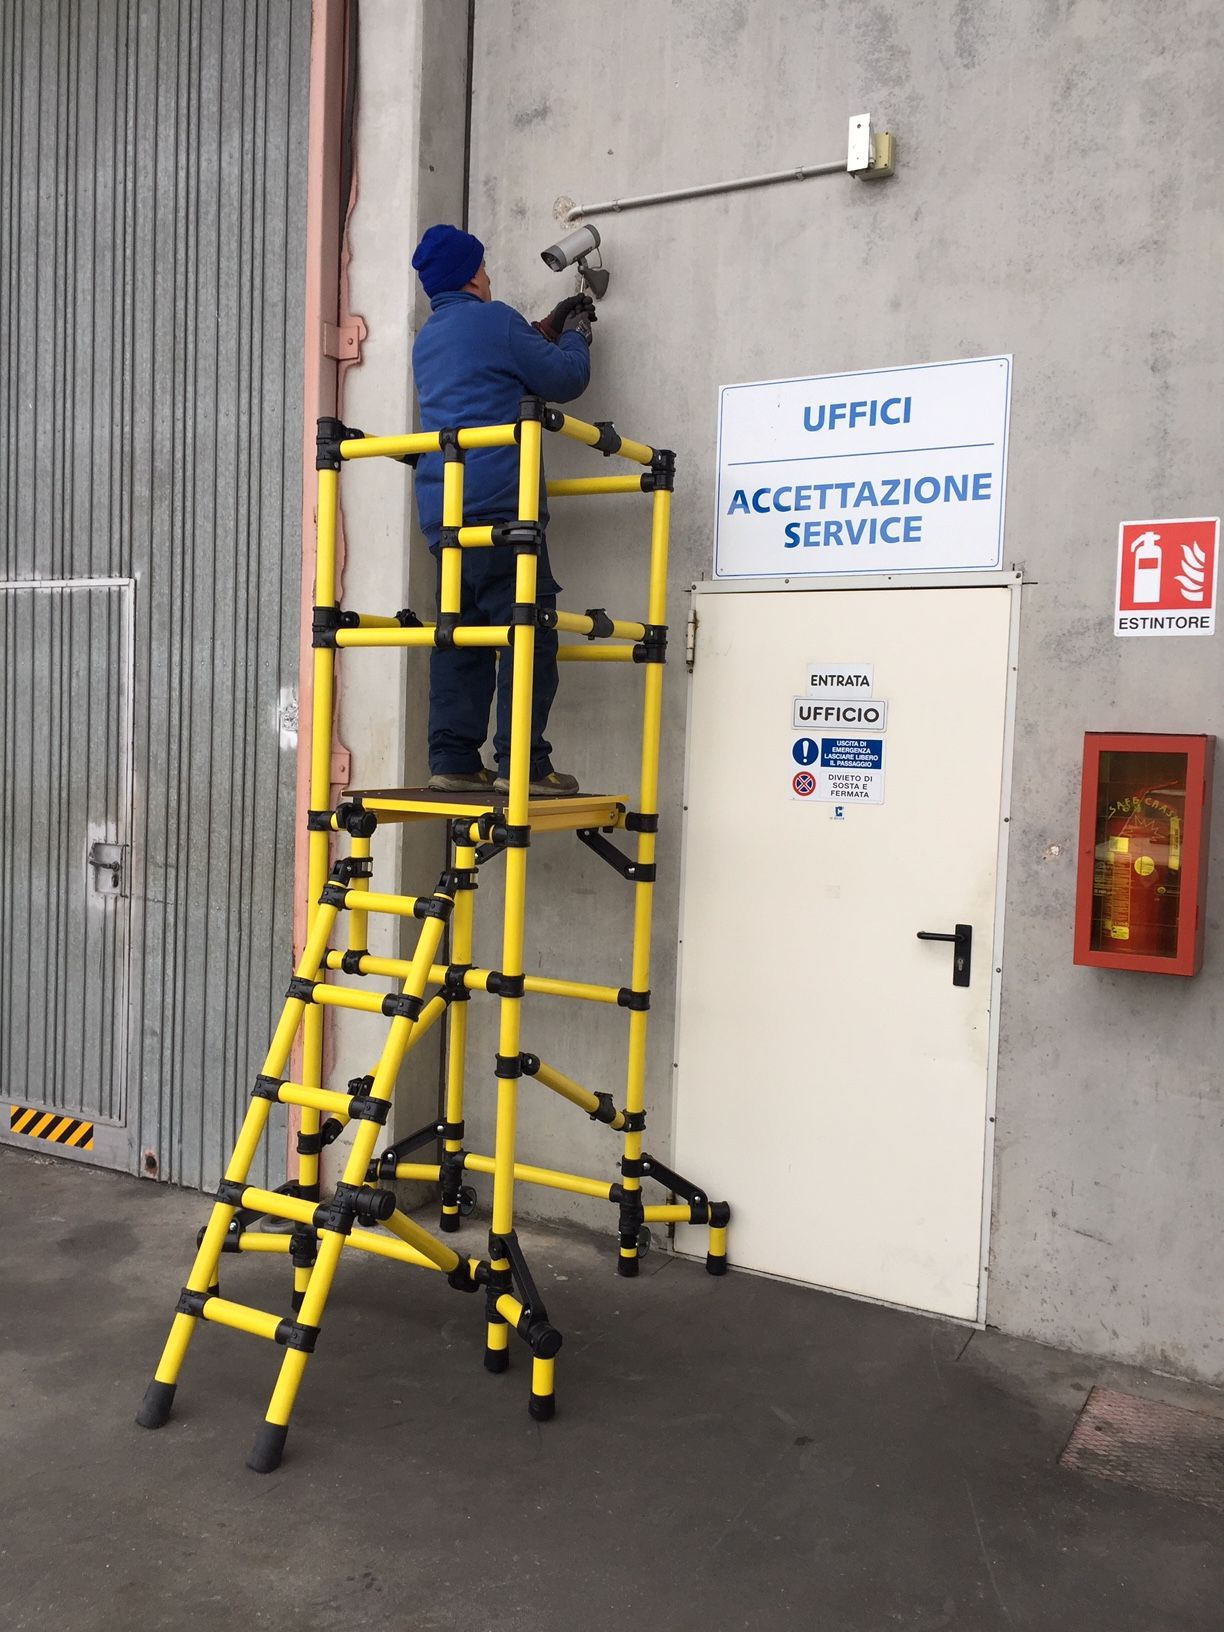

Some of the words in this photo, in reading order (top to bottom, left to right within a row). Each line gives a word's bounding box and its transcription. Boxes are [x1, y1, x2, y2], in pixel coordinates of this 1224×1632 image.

[802, 396, 912, 432] UFFICI
[727, 472, 992, 515] ACCETTAZIONE
[784, 515, 923, 548] SERVICE
[1119, 616, 1210, 630] ESTINTORE
[810, 674, 870, 687] ENTRATA
[799, 705, 880, 723] UFFICIO
[832, 746, 871, 754] EMERGENZA
[836, 760, 872, 768] PASSAGGIO
[828, 773, 861, 782] DIVIETO
[832, 782, 860, 790] SOSTA
[830, 790, 869, 798] FERMATA
[1108, 796, 1140, 820] SAFE
